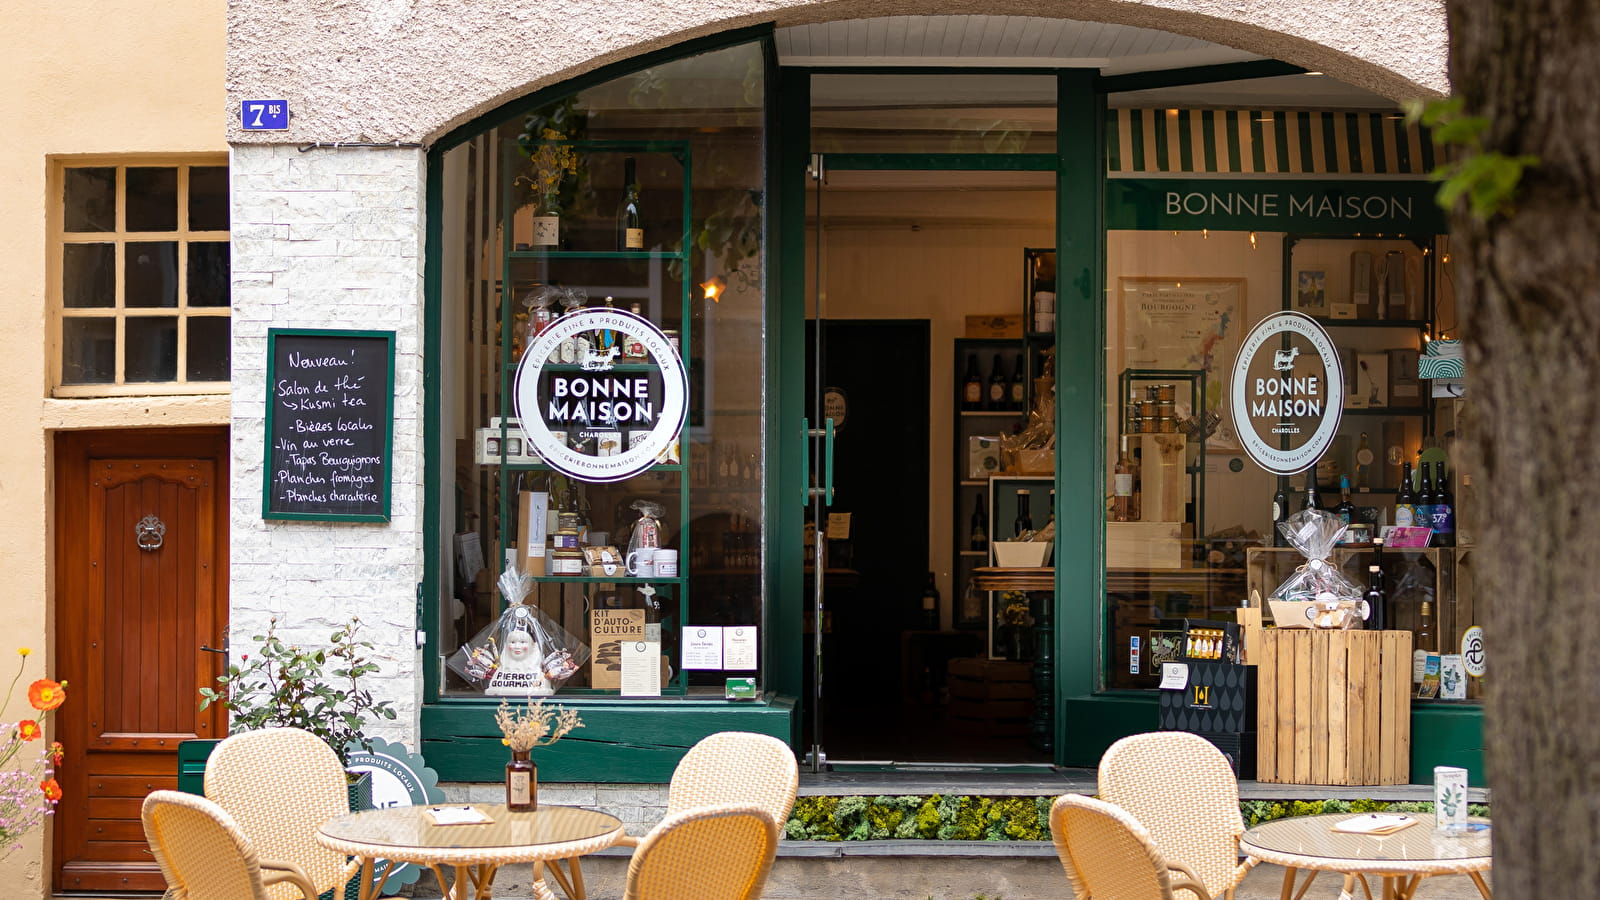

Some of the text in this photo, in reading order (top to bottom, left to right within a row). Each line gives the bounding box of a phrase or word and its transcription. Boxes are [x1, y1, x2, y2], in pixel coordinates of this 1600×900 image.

[250, 104, 281, 127] 7 BIS
[1166, 191, 1412, 219] BONNE MAISON
[533, 332, 562, 369] EPICERIE
[563, 320, 585, 334] FINE
[599, 317, 646, 337] PRODUITS
[646, 336, 670, 371] LOCAUX
[1261, 323, 1276, 337] FINE
[1285, 319, 1315, 338] PRODUITS
[1315, 337, 1332, 369] LOCAUX
[278, 374, 366, 397] Salon de thé
[554, 377, 649, 399] BONNE
[1256, 377, 1318, 396] BONNE
[300, 393, 367, 410] Kusmi tea
[1252, 399, 1320, 417] MAISON
[549, 401, 653, 422] MAISON
[303, 440, 319, 449] au
[322, 437, 355, 447] verre
[319, 451, 381, 471] Bourguignons
[330, 470, 375, 489] fromages
[594, 610, 610, 618] KIT
[594, 618, 633, 626] D'AUTO-
[594, 625, 642, 634] CULTURE
[496, 672, 538, 680] PIERROT
[354, 757, 414, 793] PRODUITS LOCAUX
